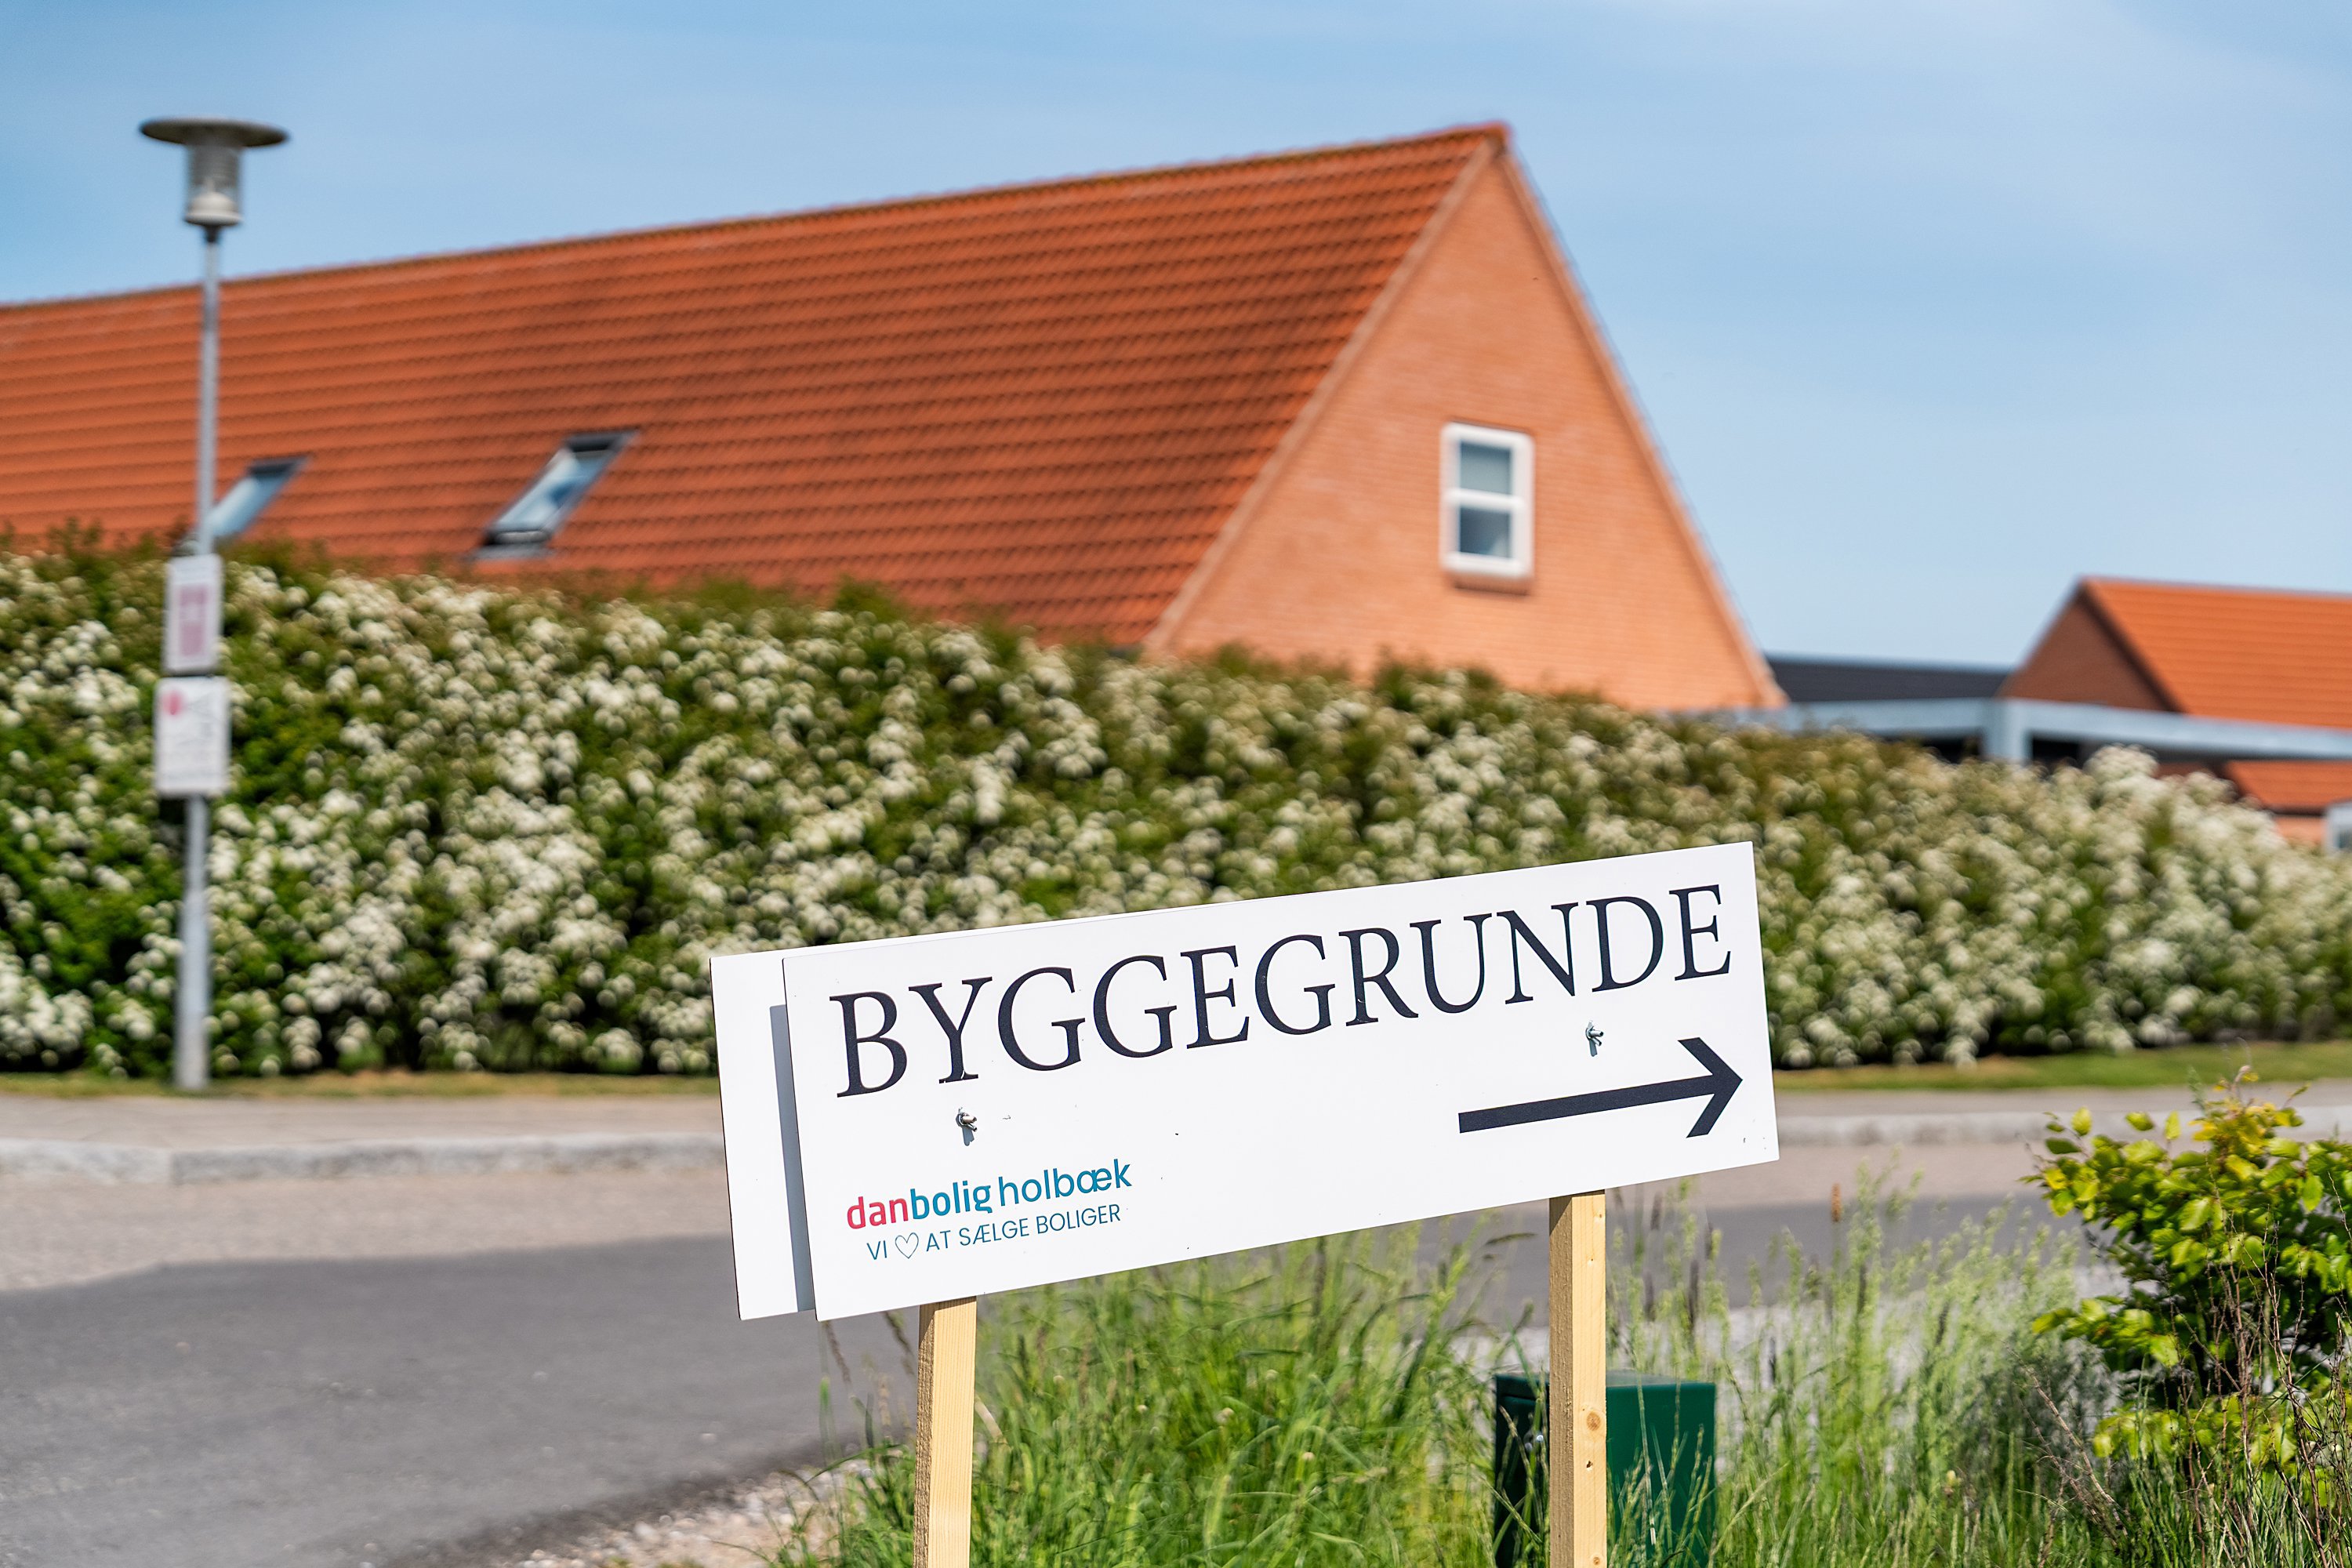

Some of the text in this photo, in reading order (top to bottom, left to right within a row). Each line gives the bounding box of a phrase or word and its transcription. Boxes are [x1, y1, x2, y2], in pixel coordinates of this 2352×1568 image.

[829, 884, 1733, 1098] BYGGEGRUNDE
[847, 1158, 1132, 1229] danbolig holbæk
[866, 1203, 1121, 1261] VI AT SÆLGE BOLIGER
